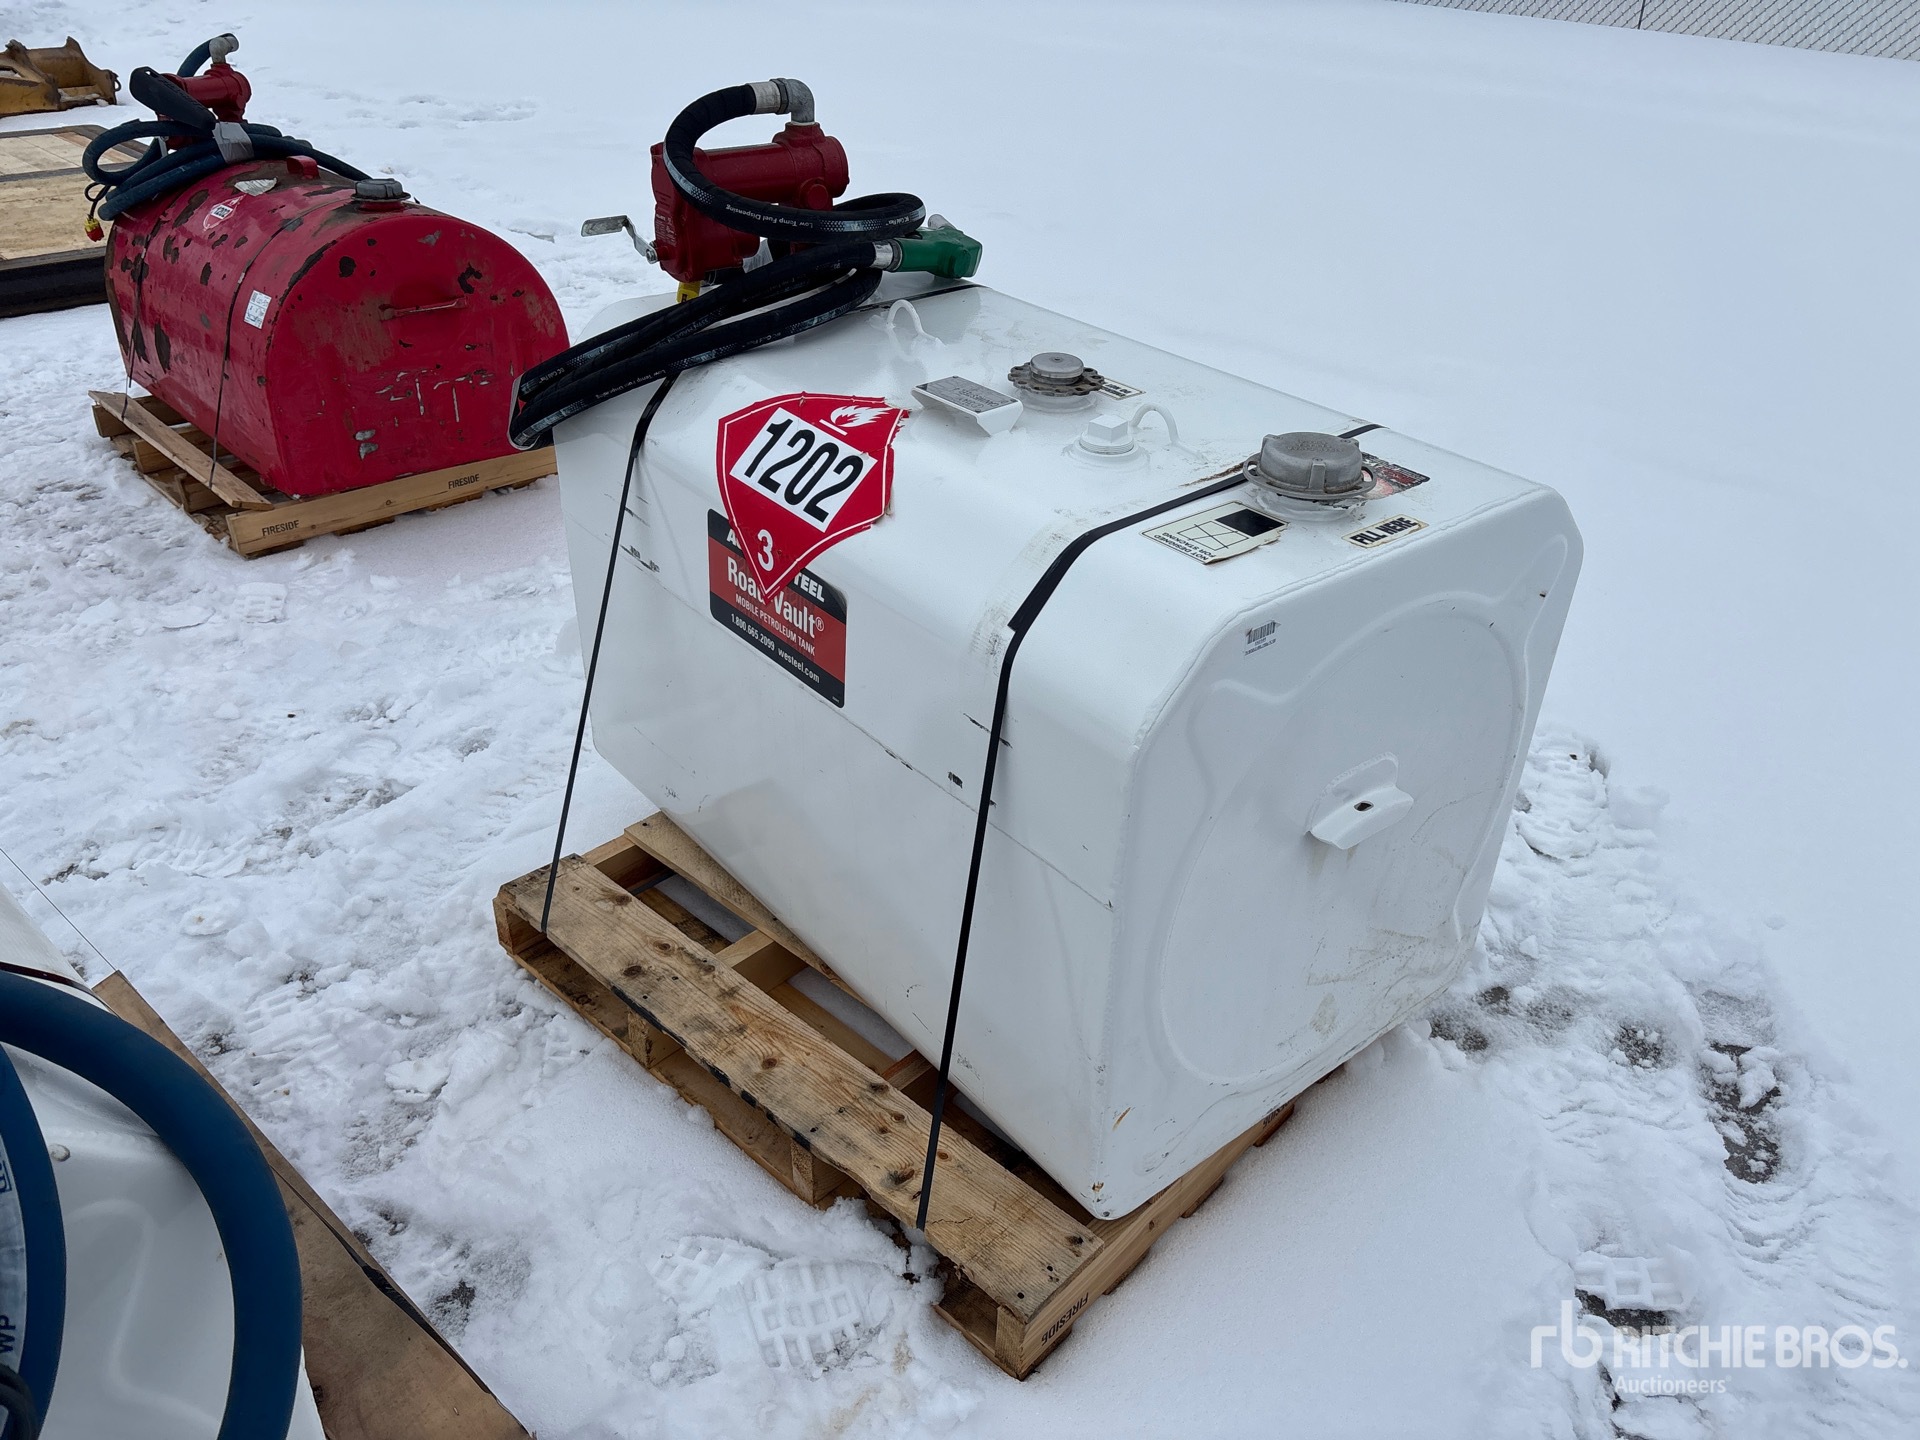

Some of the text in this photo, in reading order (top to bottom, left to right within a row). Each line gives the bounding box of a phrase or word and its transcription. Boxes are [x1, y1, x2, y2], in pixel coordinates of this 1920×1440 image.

[725, 203, 814, 229] Low Temp Fuel Dispensing
[447, 473, 481, 490] FIRESIDE
[743, 418, 865, 524] 1202
[261, 518, 300, 538] FIRESIDE
[1349, 517, 1419, 545] FILL HERE
[757, 528, 775, 572] 3
[1153, 534, 1209, 561] NOT DESIGNED
[1162, 532, 1217, 559] FOR STACKING
[735, 592, 816, 657] MOBILE PETROLEUM TANK
[731, 613, 820, 684] 1.800.665.2099 westeel.com
[1040, 1291, 1089, 1348] FIRESIDE
